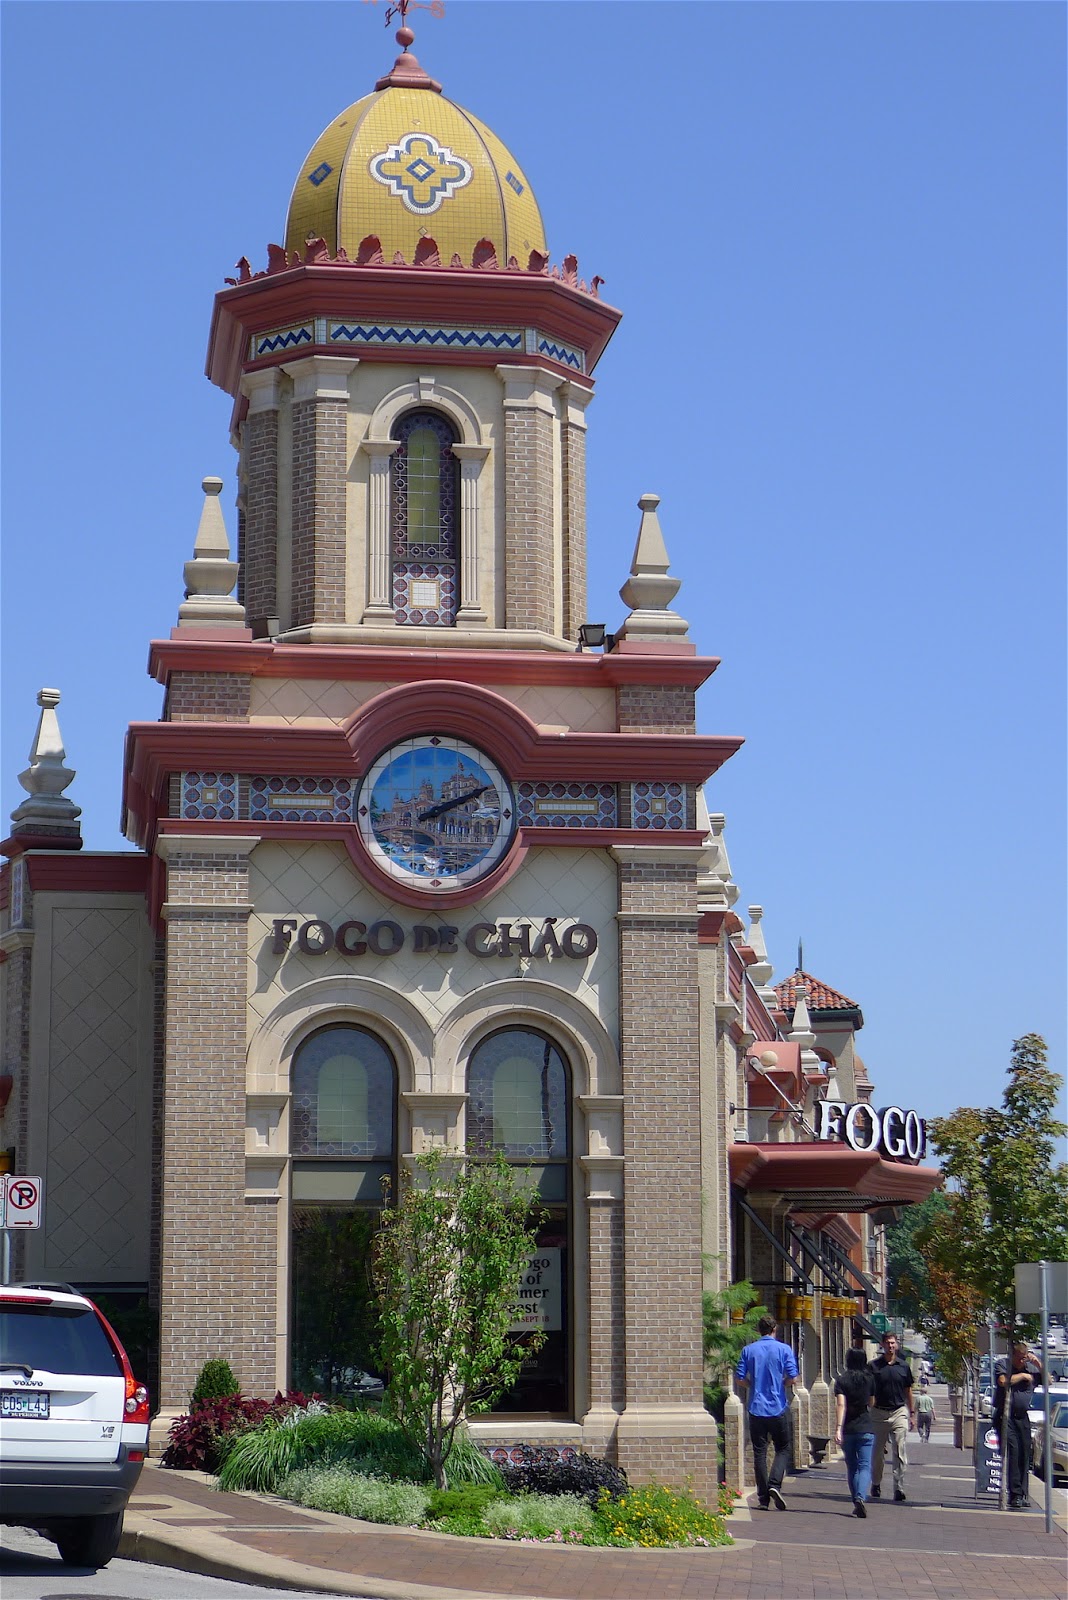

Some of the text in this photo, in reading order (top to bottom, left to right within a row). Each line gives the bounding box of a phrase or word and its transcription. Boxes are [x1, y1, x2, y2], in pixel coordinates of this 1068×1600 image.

[271, 917, 598, 959] FOGO DE CHÃO
[817, 1100, 921, 1159] FOGO
[526, 1271, 543, 1285] of
[517, 1288, 550, 1299] mer
[502, 1302, 539, 1314] east
[521, 1315, 539, 1323] SEPT
[12, 1379, 44, 1387] VOLVO
